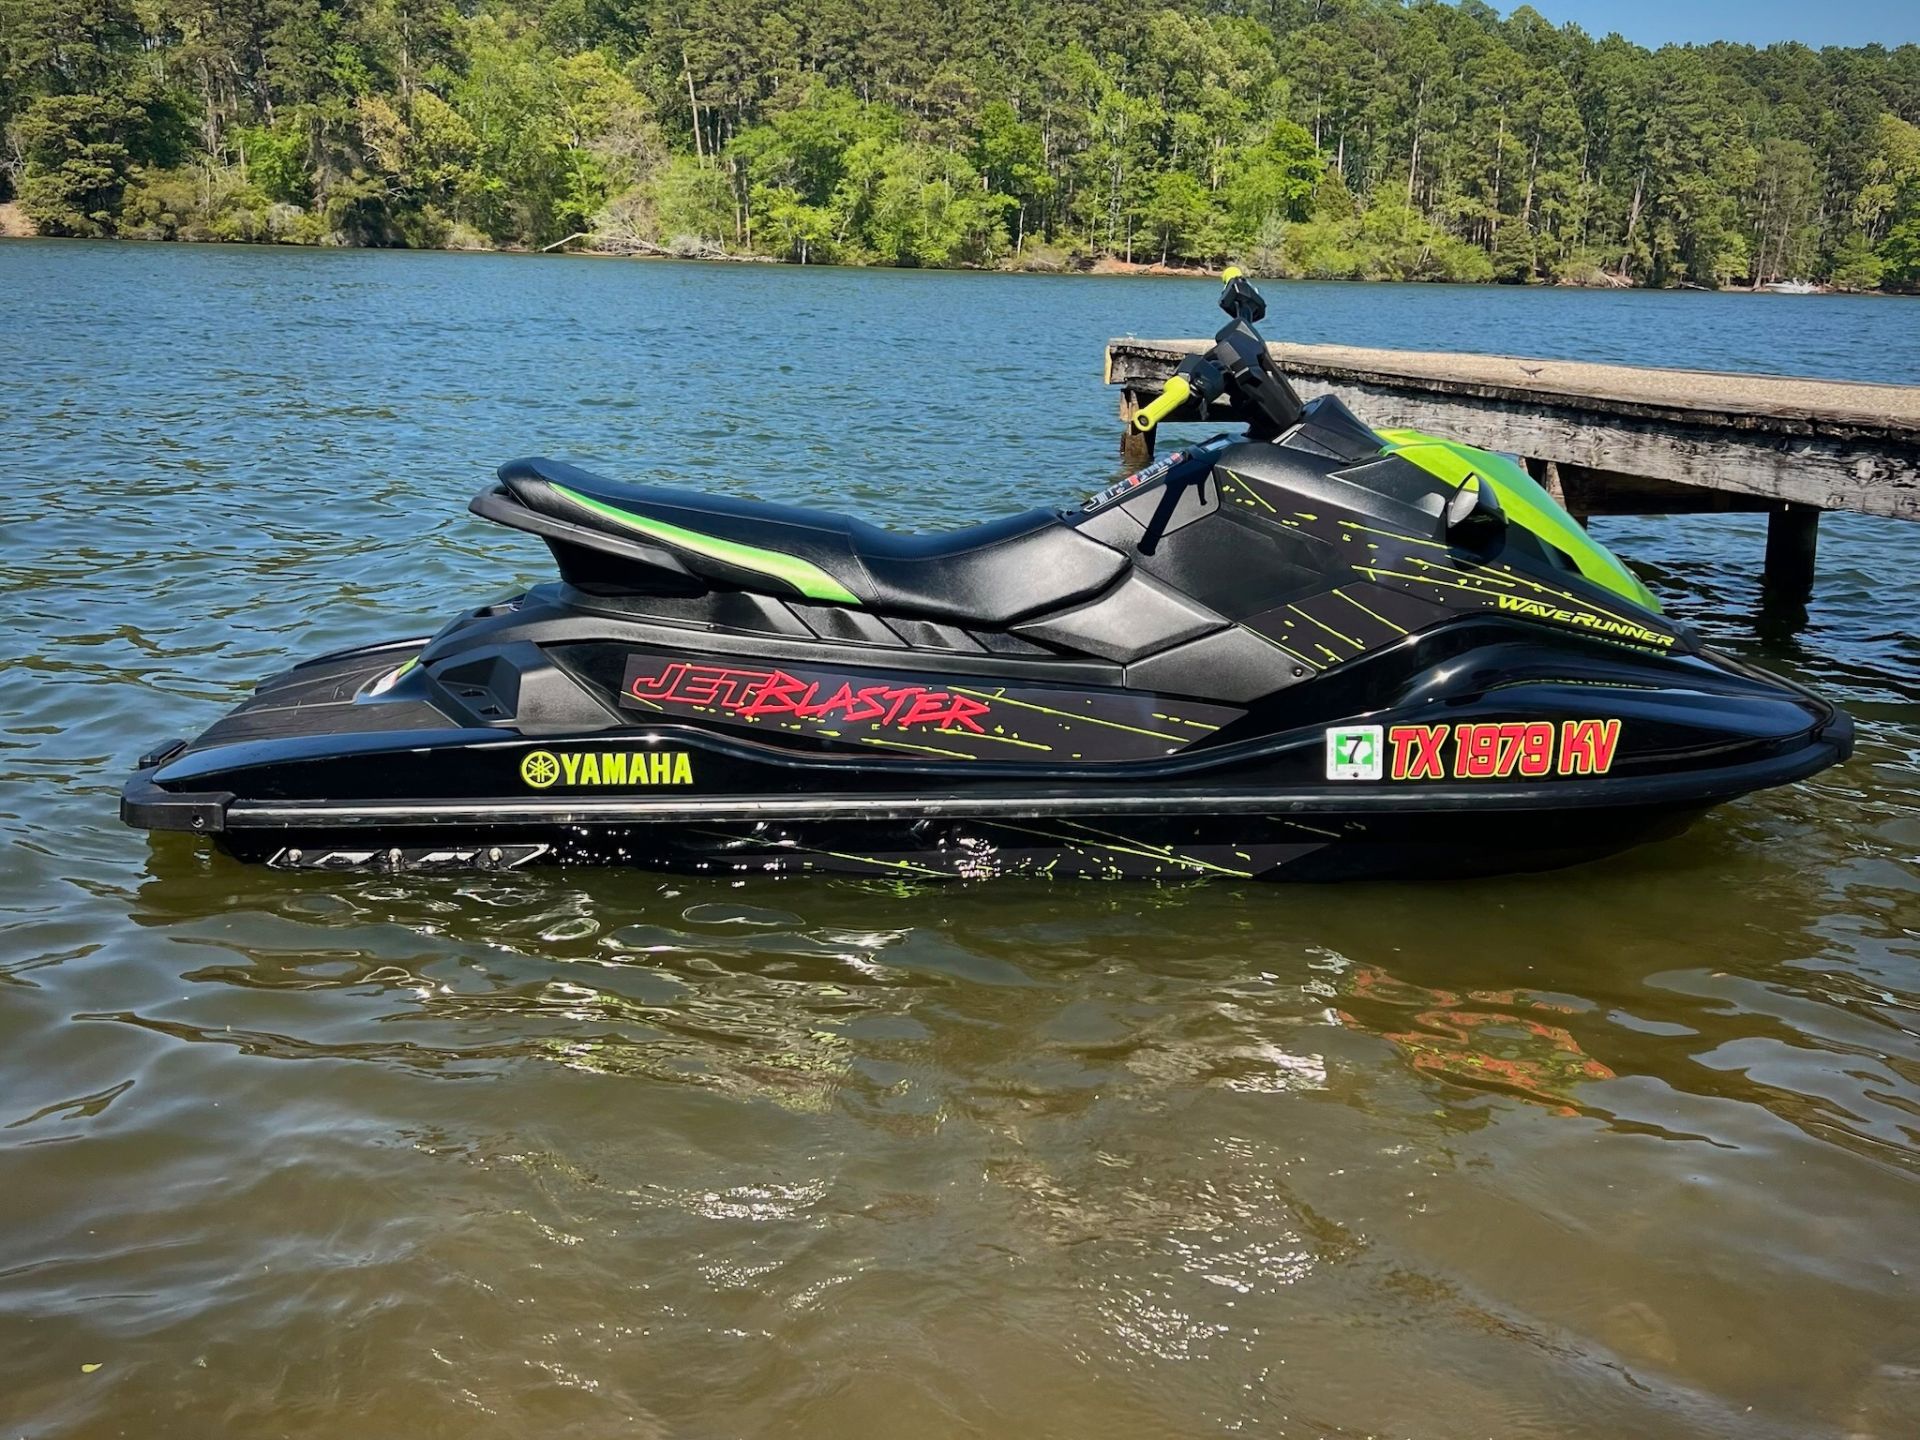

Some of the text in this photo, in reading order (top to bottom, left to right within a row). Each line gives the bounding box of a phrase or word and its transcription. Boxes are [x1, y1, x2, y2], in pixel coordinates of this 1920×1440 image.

[1499, 595, 1675, 647] WAVERUNNER
[560, 752, 694, 785] YAMAHA
[1345, 735, 1363, 764] 7
[1389, 725, 1450, 780] TX
[1454, 721, 1554, 778] 1979
[1558, 719, 1621, 774] KV
